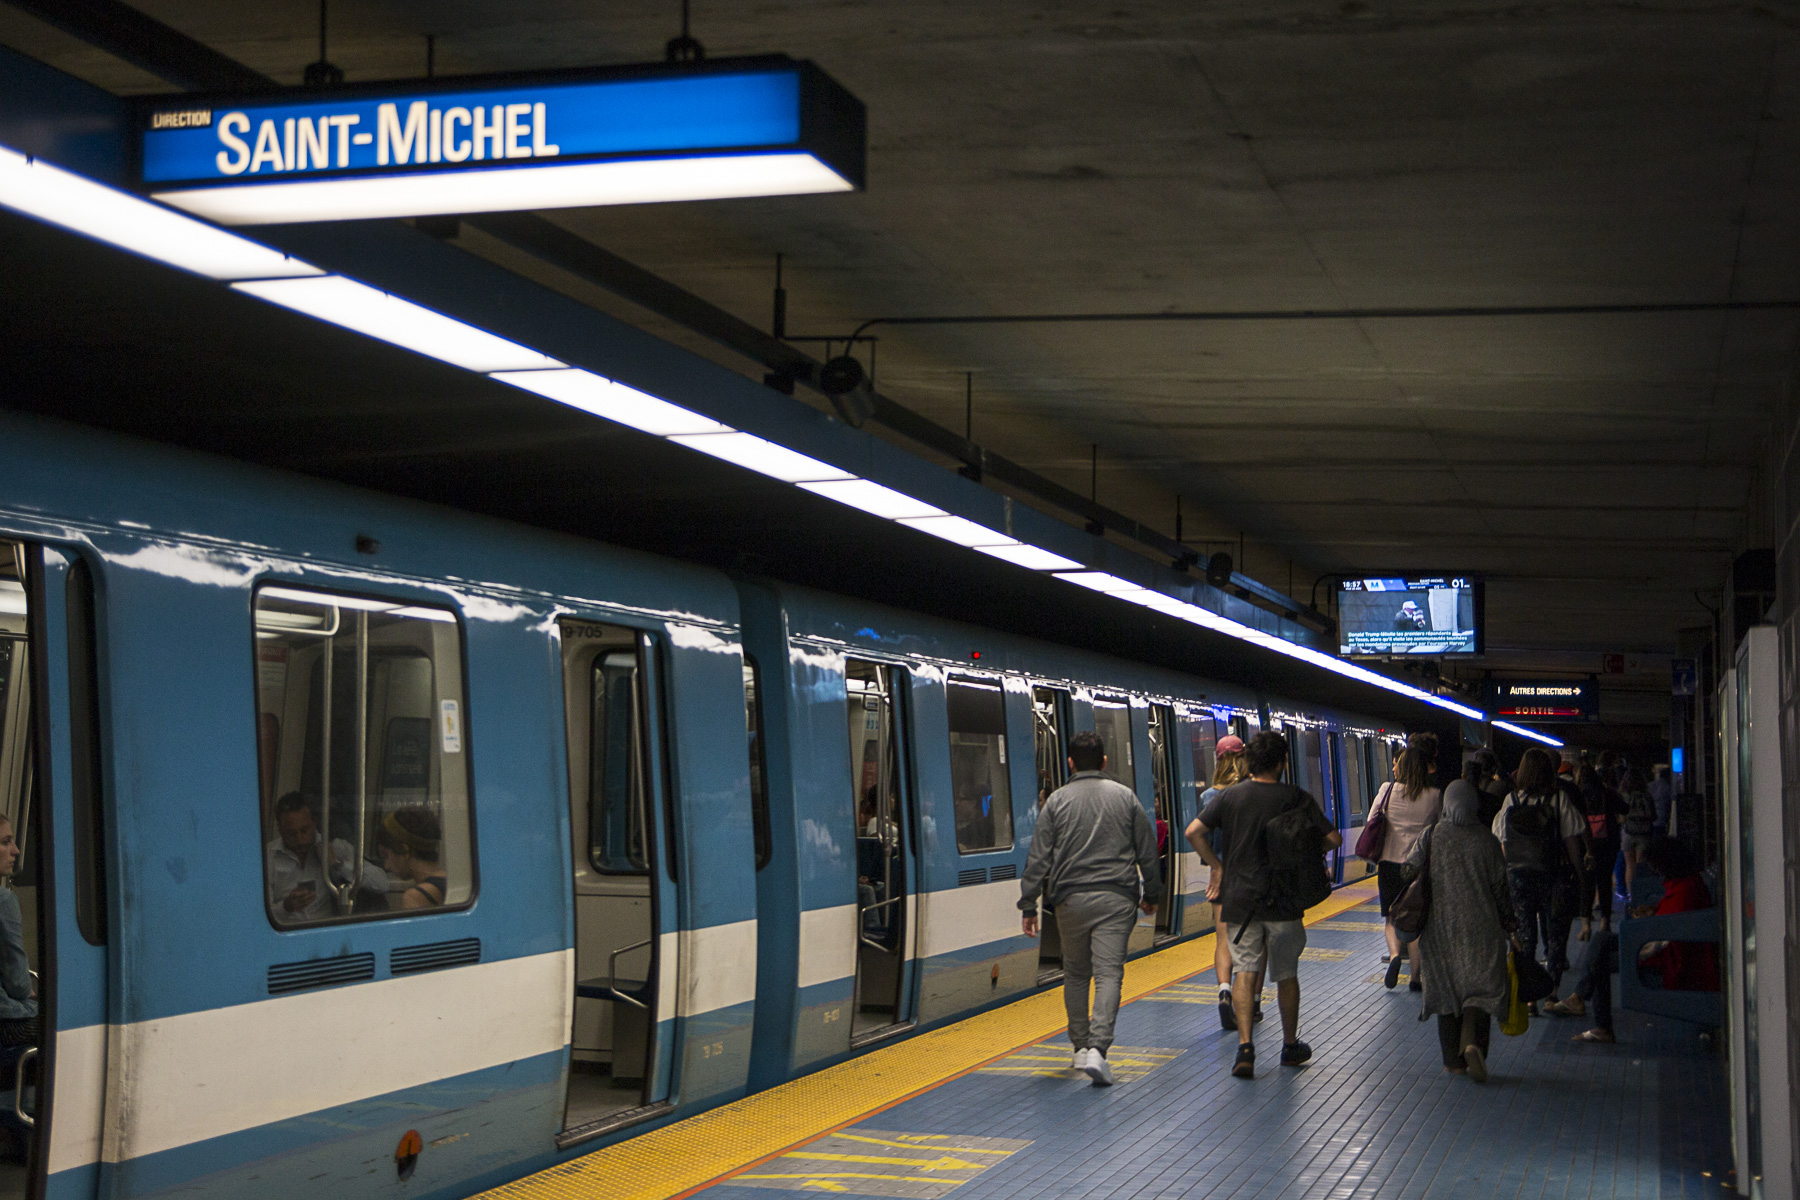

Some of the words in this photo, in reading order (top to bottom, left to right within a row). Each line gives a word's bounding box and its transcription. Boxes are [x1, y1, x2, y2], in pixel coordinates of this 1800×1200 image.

[152, 110, 212, 129] DIRECTION
[215, 101, 560, 175] SAINT-MICHEL
[1452, 579, 1464, 588] 01
[1510, 686, 1535, 695] AUTRES
[1536, 687, 1572, 696] DIRECTIONS
[1515, 707, 1554, 715] SORTIE
